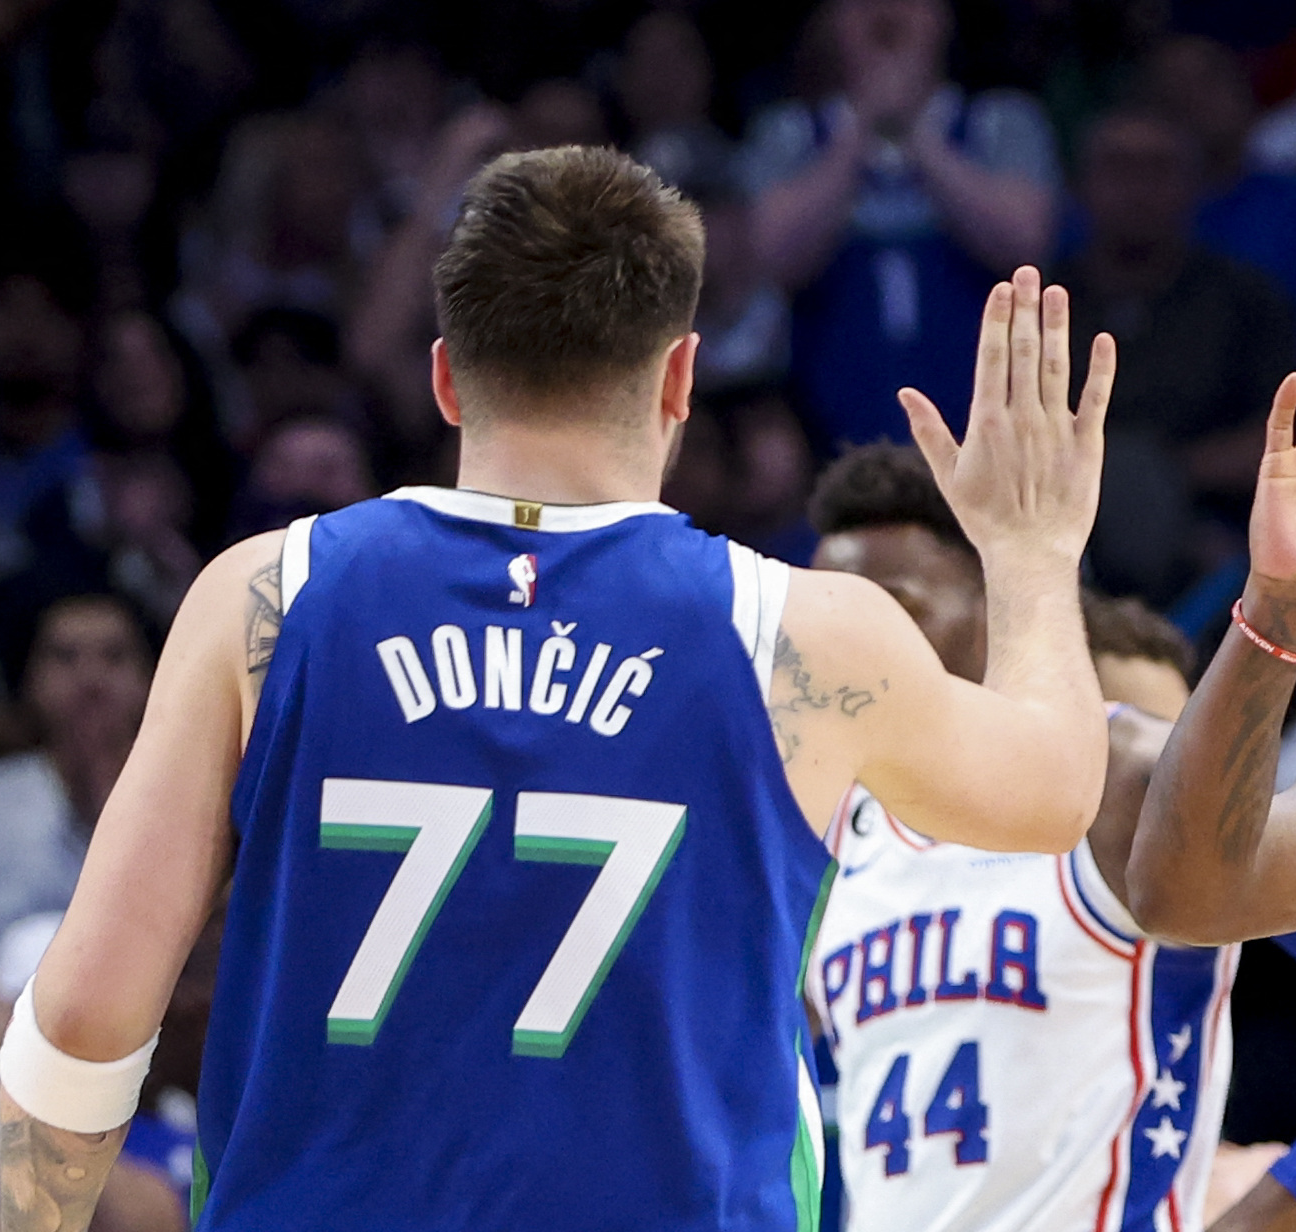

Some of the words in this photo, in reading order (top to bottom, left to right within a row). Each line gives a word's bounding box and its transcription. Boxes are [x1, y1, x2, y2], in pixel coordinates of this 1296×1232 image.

[376, 620, 665, 737] DONČIĆ
[319, 776, 688, 1059] 77
[821, 907, 1049, 1047] PHILA
[864, 1041, 990, 1180] 44
